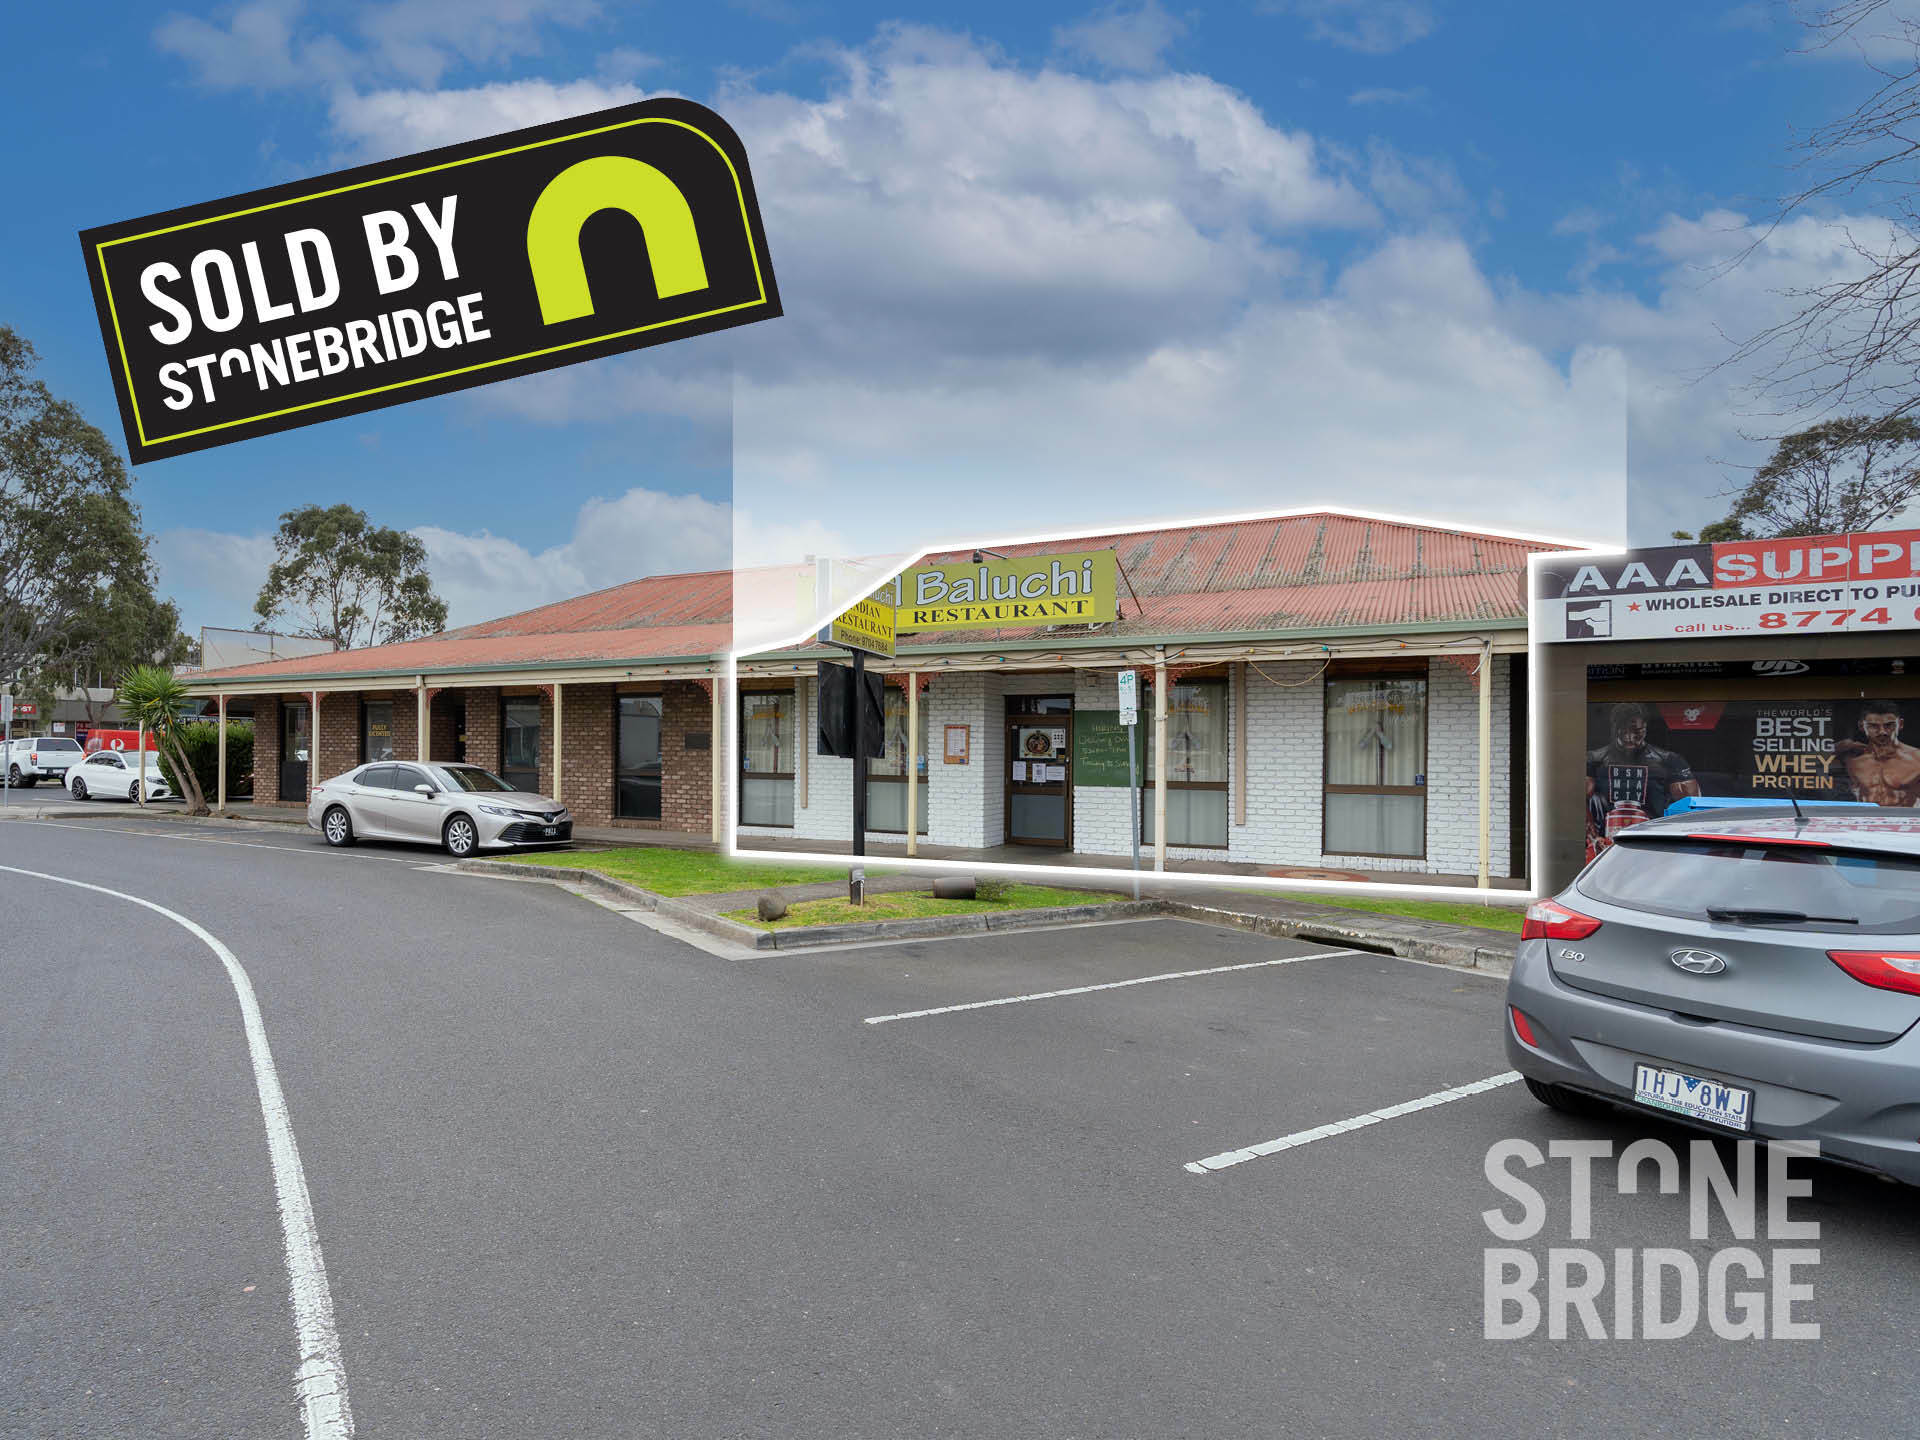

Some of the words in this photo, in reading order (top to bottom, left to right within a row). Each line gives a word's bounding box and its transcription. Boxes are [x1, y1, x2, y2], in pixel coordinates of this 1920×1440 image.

[1568, 558, 1710, 592] AAA
[1714, 540, 1920, 583] SUPP
[916, 558, 1093, 606] Baluchi
[1645, 593, 1762, 611] WHOLESALE
[1768, 588, 1844, 605] DIRECT
[1850, 586, 1879, 600] TO
[1886, 583, 1920, 599] PU
[913, 599, 1090, 624] RESTAURANT
[1674, 623, 1706, 633] call
[1758, 607, 1893, 629] 8774
[1120, 673, 1134, 684] 4P
[1757, 709, 1777, 717] THE
[1779, 708, 1833, 717] WORLD'S
[1756, 717, 1832, 737] BEST
[1752, 738, 1836, 752] SELLING
[1754, 754, 1836, 774] WHEY
[1752, 775, 1833, 790] PROTEIN
[1684, 1101, 1722, 1116] EDUCATION
